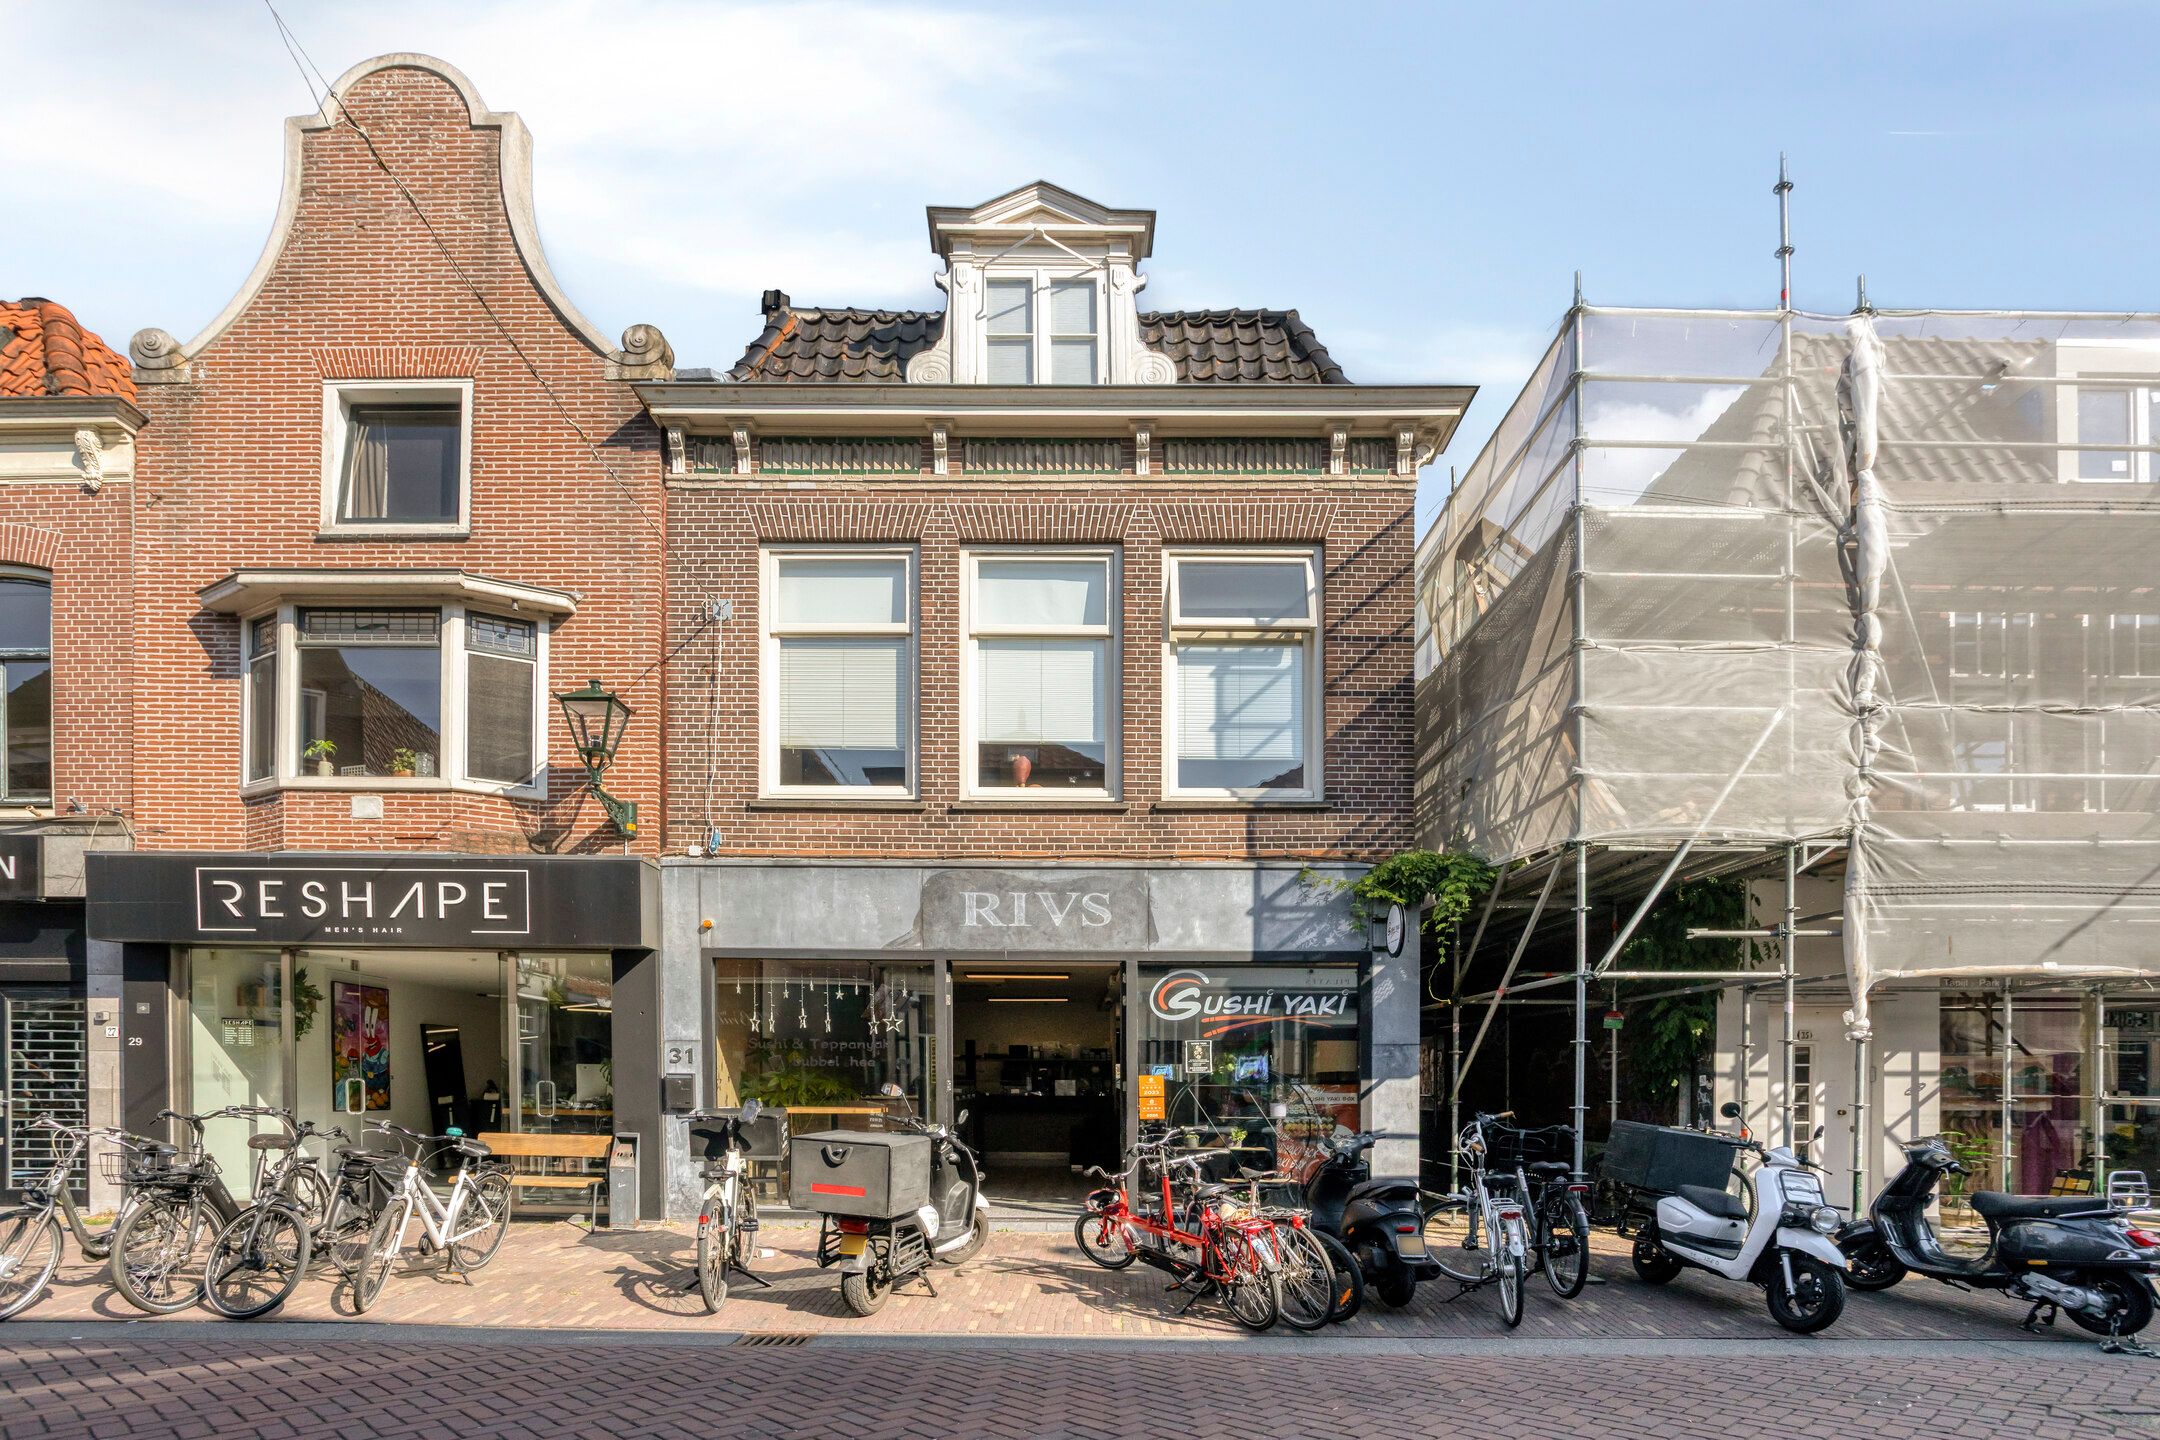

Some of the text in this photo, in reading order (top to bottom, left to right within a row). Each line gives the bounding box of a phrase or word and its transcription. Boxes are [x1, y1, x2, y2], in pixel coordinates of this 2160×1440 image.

[213, 880, 507, 920] RESHAPE
[959, 891, 1112, 927] RIVS
[128, 1037, 143, 1046] 29
[669, 1047, 694, 1065] 31
